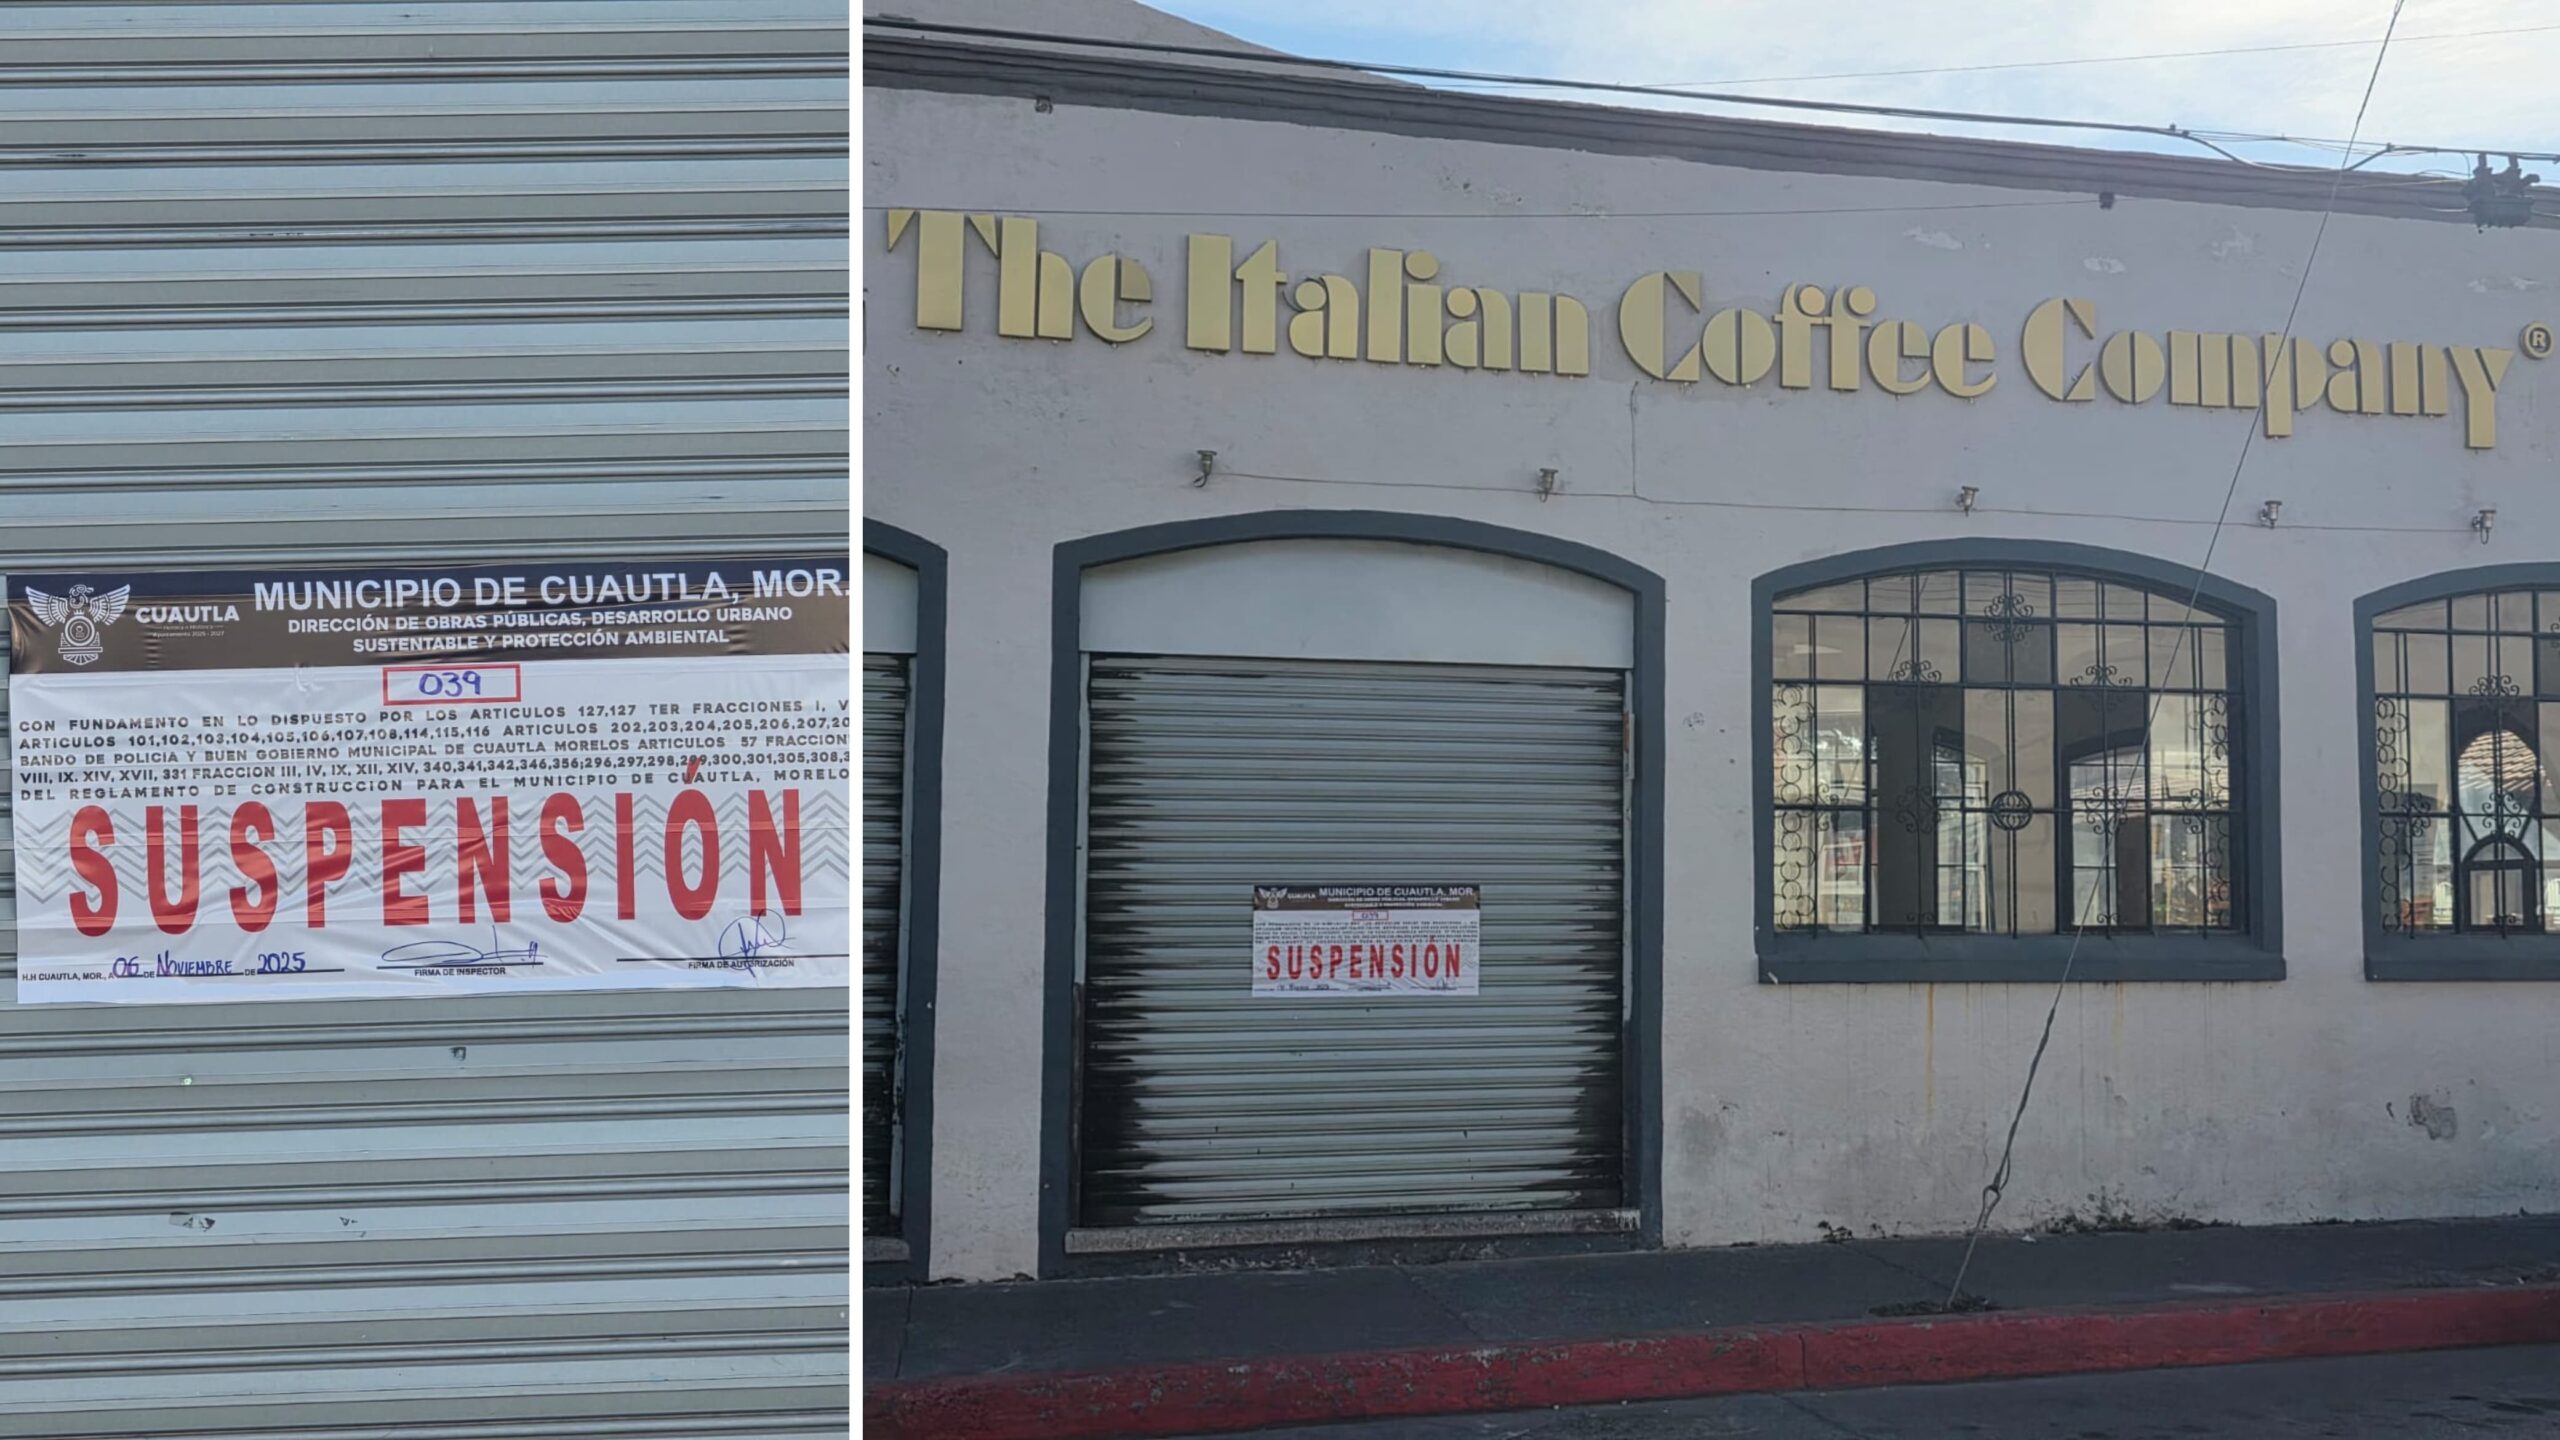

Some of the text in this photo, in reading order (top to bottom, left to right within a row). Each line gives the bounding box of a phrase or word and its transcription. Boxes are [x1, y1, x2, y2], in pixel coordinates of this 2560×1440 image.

[887, 208, 1154, 343] The
[1186, 232, 1590, 377] Italian
[1619, 270, 1997, 398] Coffee
[2021, 295, 2513, 450] Company
[254, 568, 849, 611] MUNICIPIO DE CUAUTLA, MOR.
[135, 605, 240, 624] CUAUTLA
[288, 607, 793, 633] DIRECCIÓN DE OBRAS PÚBLICAS, DESARROLLO URBANO
[353, 628, 730, 652] SUSTENTABLE Y PROTECCIÓN AMBIENTAL
[418, 671, 481, 697] 039
[19, 720, 56, 732] CON
[69, 716, 189, 731] FUNDAMENTO
[202, 716, 224, 727] EN
[238, 715, 258, 727] LO
[271, 712, 367, 725] DISPUESTO
[380, 711, 413, 723] POR
[426, 709, 458, 721] LOS
[470, 706, 566, 720] ARTICULOS
[578, 705, 636, 717] 127,127
[649, 703, 680, 715] TER
[692, 701, 803, 715] FRACCIONES
[19, 736, 116, 750] ARTICULOS
[503, 723, 598, 737] ARTICULOS
[20, 734, 849, 767] BANDO DE POLICIA Y BUEN GOBIERNO MUNICIPAL DE CUAUTLA MORELOS ARTICULOS 57 FRACCION
[20, 772, 53, 784] VIII,
[83, 770, 115, 782] XIV,
[119, 769, 158, 781] XVII,
[162, 768, 187, 780] 331
[192, 765, 275, 780] FRACCION
[281, 765, 301, 778] III,
[306, 764, 326, 777] IV,
[356, 763, 383, 775] XII,
[387, 762, 419, 774] XIV,
[20, 789, 55, 801] DEL
[70, 786, 199, 800] REGLAMENTO
[214, 784, 237, 796] DE
[251, 780, 402, 795] CONSTRUCCION
[417, 778, 465, 790] PARA
[479, 777, 500, 788] EL
[514, 774, 618, 787] MUNICIPIO
[631, 773, 654, 784] DE
[69, 757, 802, 938] SUSPENSIÓN
[1319, 887, 1374, 897] MUNICIPIO
[1376, 887, 1392, 896] DE
[38, 973, 81, 981] CUAUTLA,
[112, 956, 140, 977] 06
[244, 968, 256, 976] DE
[257, 952, 306, 973] 2025
[688, 961, 715, 969] FIRMA
[1266, 934, 1460, 980] SUSPENSIÓN
[414, 967, 506, 977] FIRMA DE INSPECTOR
